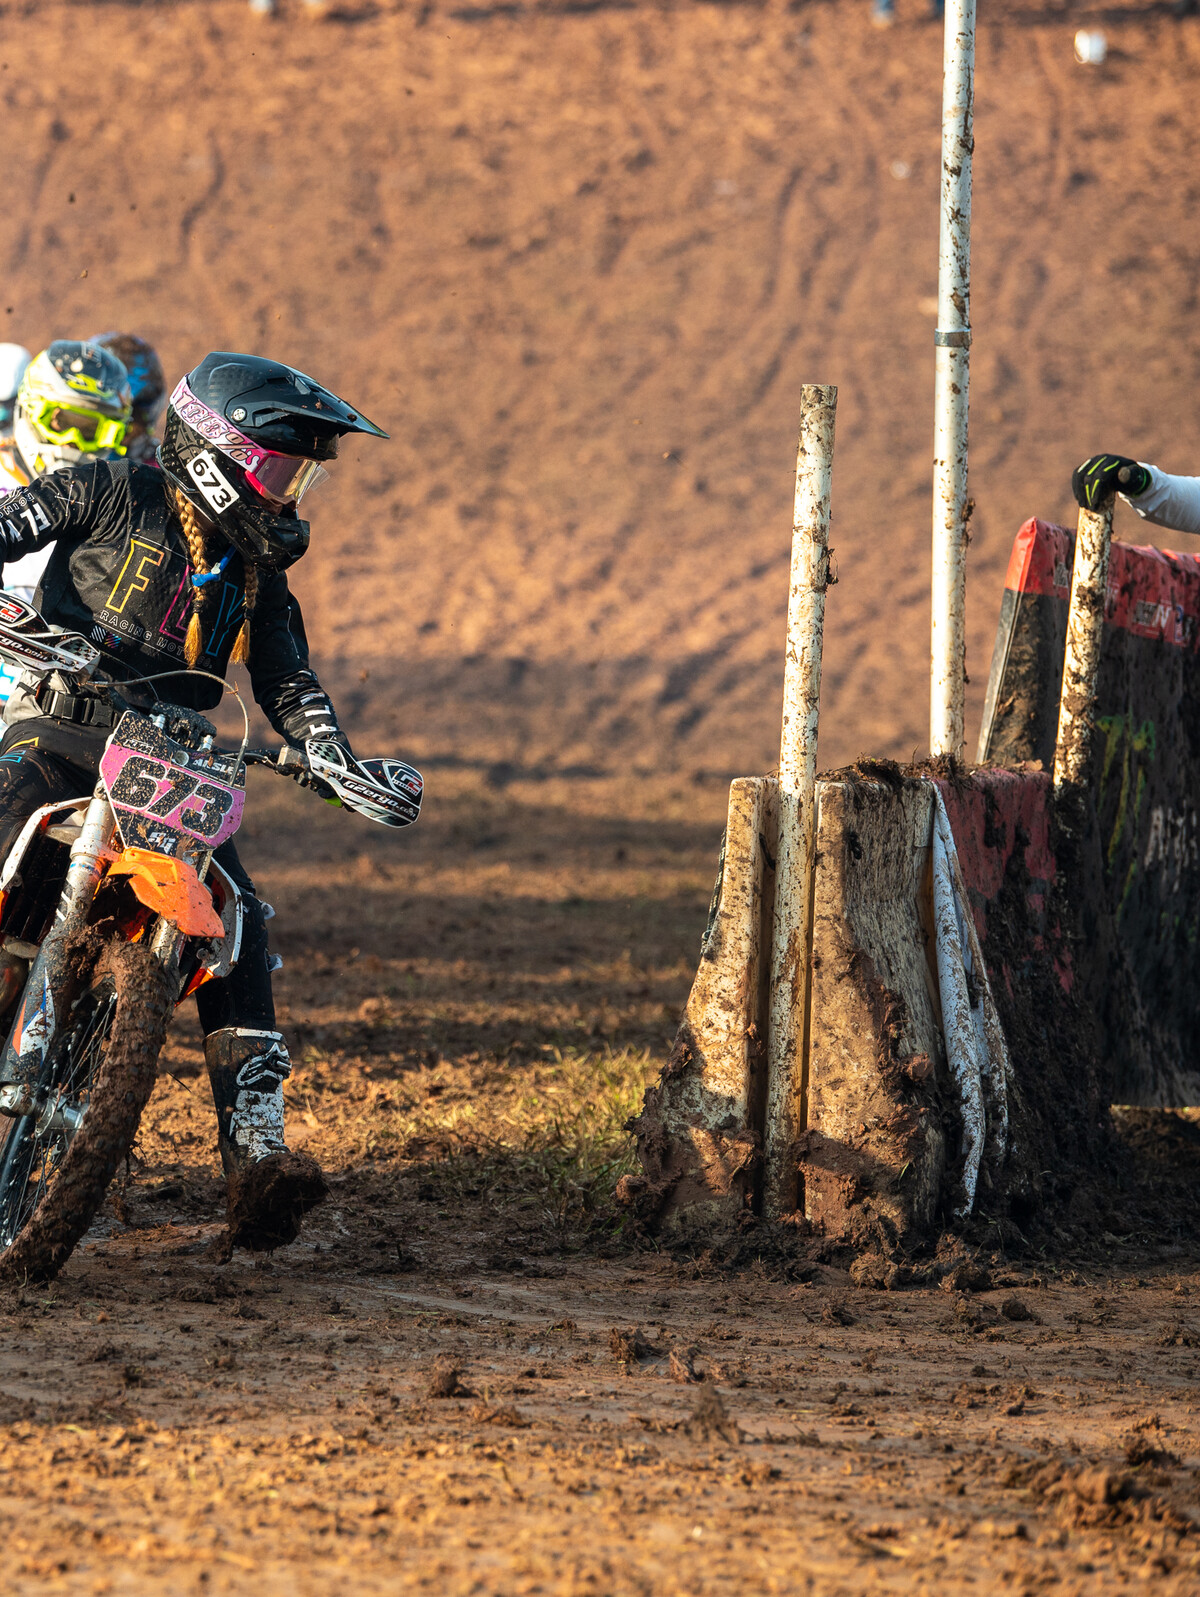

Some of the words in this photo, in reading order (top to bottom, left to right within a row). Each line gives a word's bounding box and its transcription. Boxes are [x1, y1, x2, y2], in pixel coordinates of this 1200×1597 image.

[192, 458, 232, 508] 673
[100, 610, 153, 641] RACING
[156, 637, 186, 656] MOT
[109, 755, 234, 839] 673
